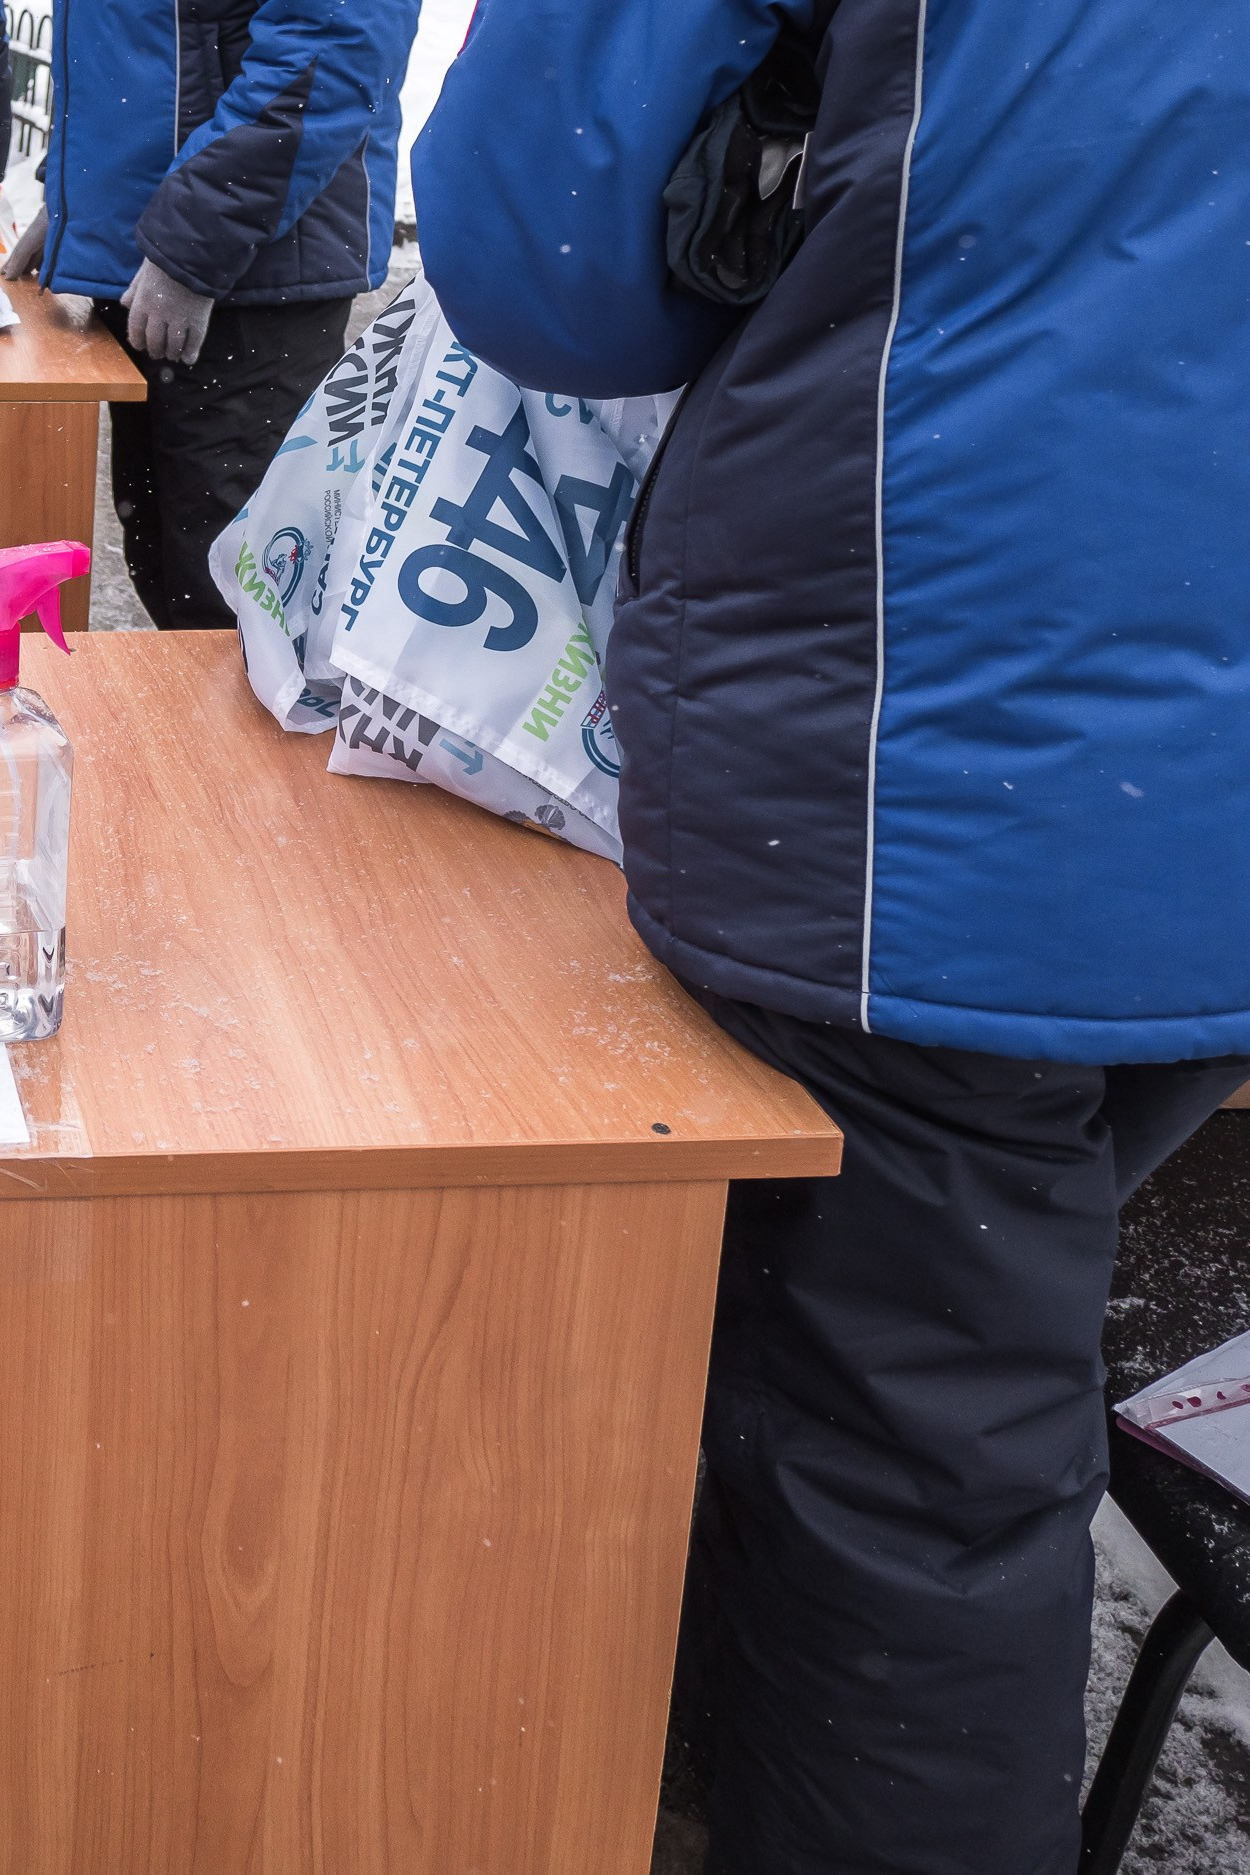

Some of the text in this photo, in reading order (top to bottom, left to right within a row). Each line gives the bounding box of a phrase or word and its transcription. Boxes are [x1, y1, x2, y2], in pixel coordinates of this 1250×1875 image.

[234, 540, 291, 637] ЖИЗН
[343, 340, 479, 632] КТ-ПЕТЕРБУРГ
[397, 401, 567, 652] 446
